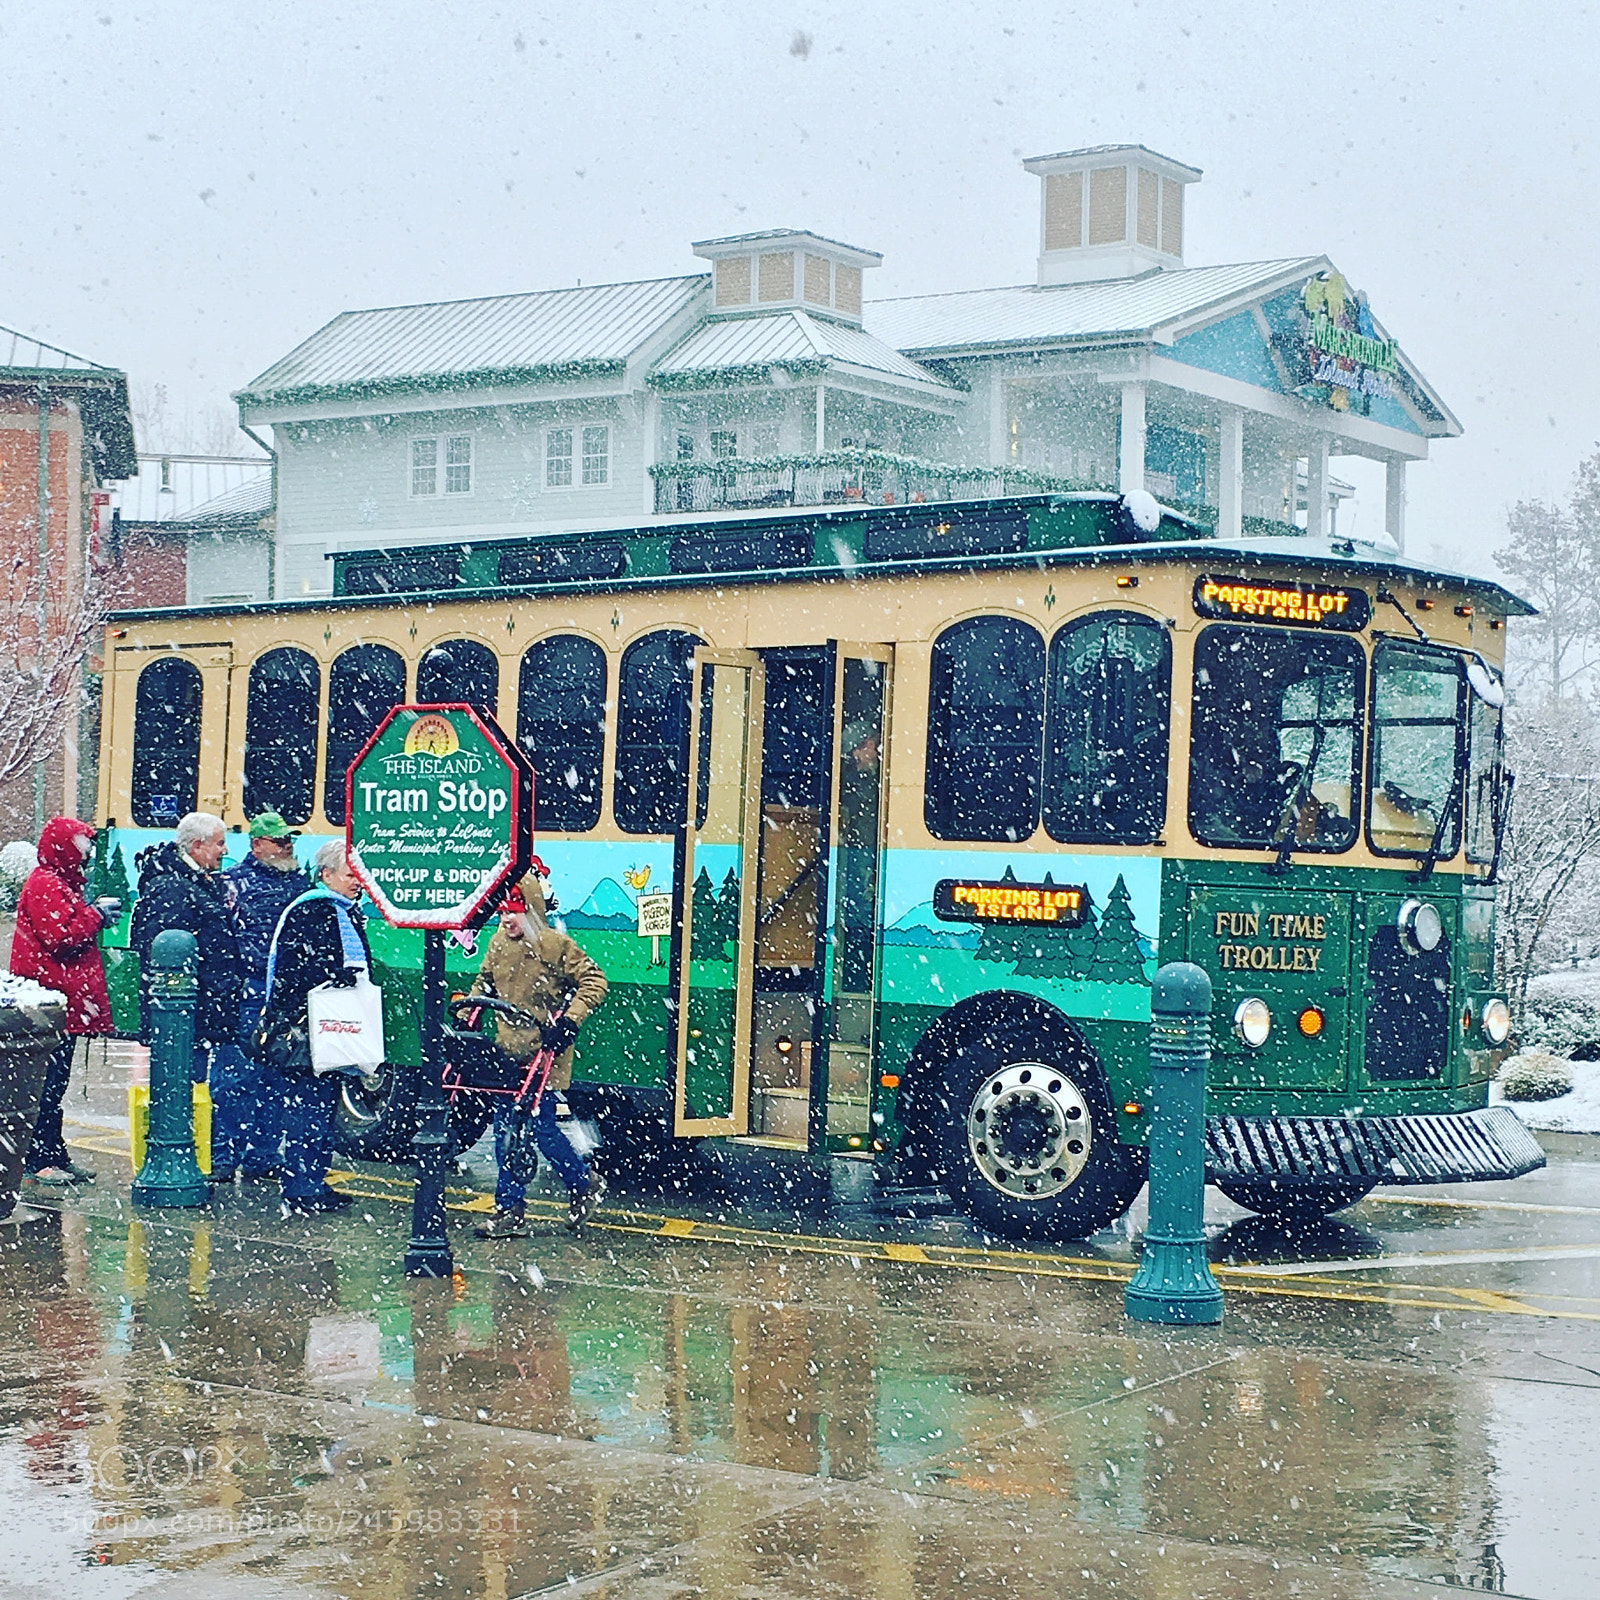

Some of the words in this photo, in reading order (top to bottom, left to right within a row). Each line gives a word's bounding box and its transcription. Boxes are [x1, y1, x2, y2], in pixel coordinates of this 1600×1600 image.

[1204, 583, 1302, 608] PARKING
[1306, 593, 1349, 614] LOT
[383, 760, 416, 774] THE
[419, 759, 481, 774] ISLAND
[359, 782, 428, 812] Tram
[438, 781, 508, 819] Stop
[370, 823, 396, 838] Tram
[399, 823, 435, 838] Service
[450, 823, 493, 840] LeConte
[354, 839, 386, 854] Center
[388, 839, 442, 856] Municipal
[444, 839, 485, 858] Parking
[371, 868, 429, 882] PICK-UP
[434, 869, 445, 883] &
[448, 868, 490, 883] DROP
[393, 888, 422, 903] OFF
[425, 888, 466, 904] HERE
[954, 886, 1041, 906] PARKING
[1044, 891, 1081, 909] LOT
[976, 903, 1058, 921] ISLAND
[1215, 911, 1260, 936] FUN
[1267, 913, 1327, 939] TIME
[1218, 944, 1322, 972] TROLLEY
